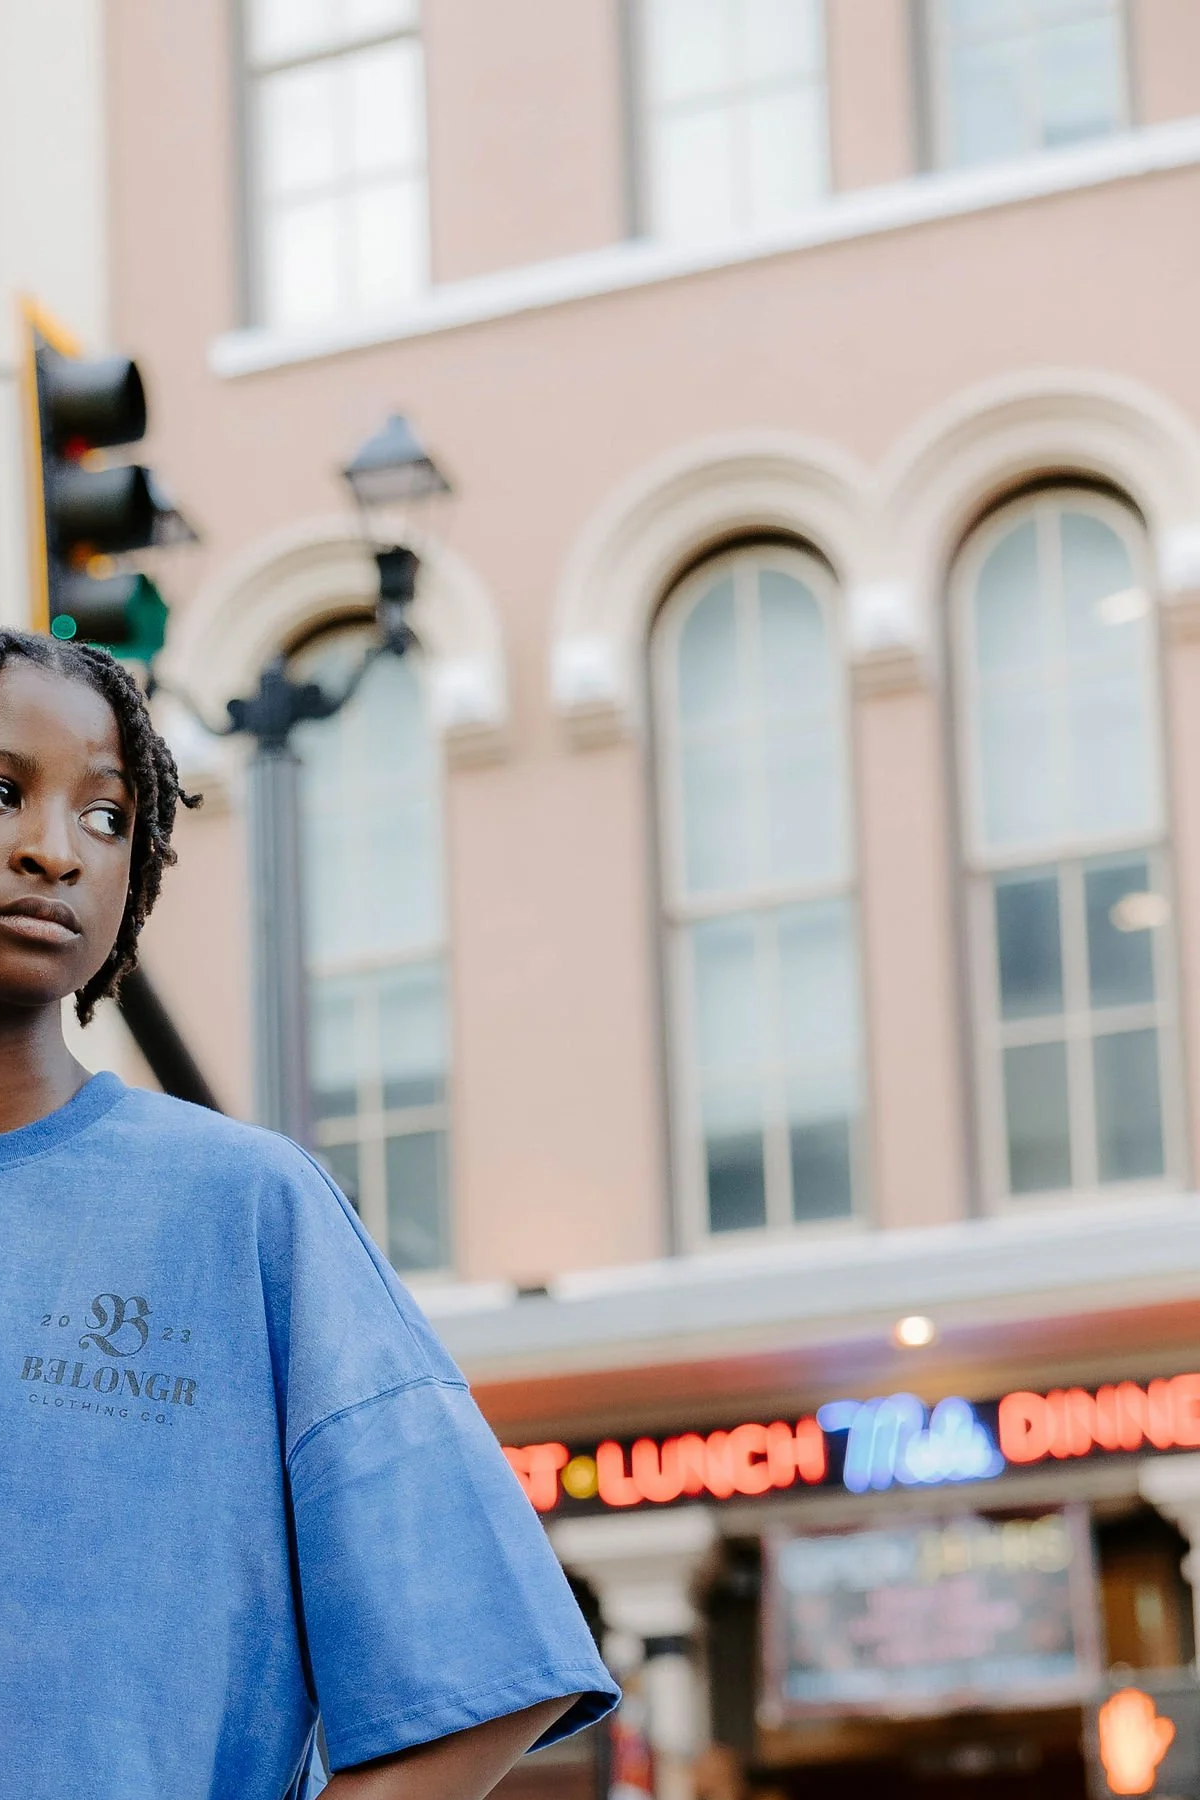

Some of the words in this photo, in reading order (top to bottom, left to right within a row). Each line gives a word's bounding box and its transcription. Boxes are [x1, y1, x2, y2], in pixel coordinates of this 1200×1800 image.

[40, 1313, 71, 1328] 20
[161, 1327, 191, 1344] 23
[29, 1393, 128, 1418] CLOTHING
[140, 1411, 174, 1426] CO.
[596, 1415, 825, 1507] LUNCH
